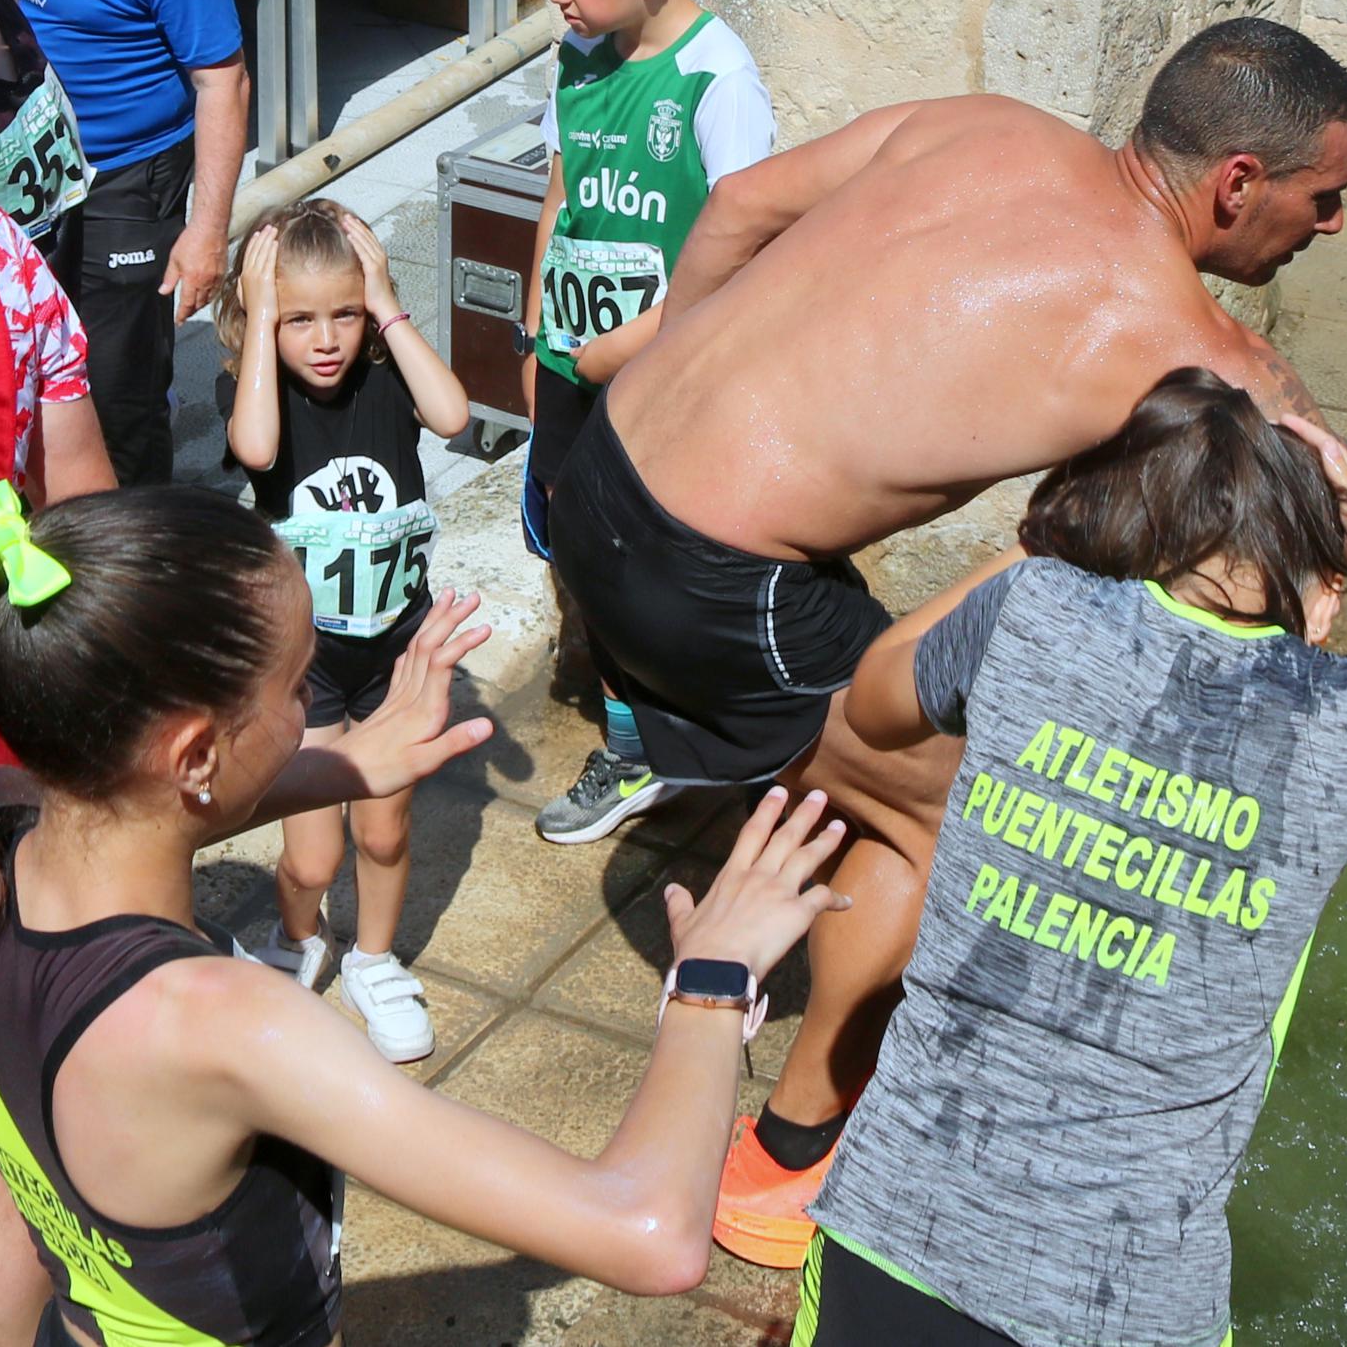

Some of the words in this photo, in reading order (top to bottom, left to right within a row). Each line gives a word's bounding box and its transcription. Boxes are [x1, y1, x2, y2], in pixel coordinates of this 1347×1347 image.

[544, 266, 660, 337] 1067
[1016, 720, 1261, 852] ATLETISMO
[962, 771, 1277, 931] PUENTECILLAS
[965, 862, 1178, 987] PALENCIA
